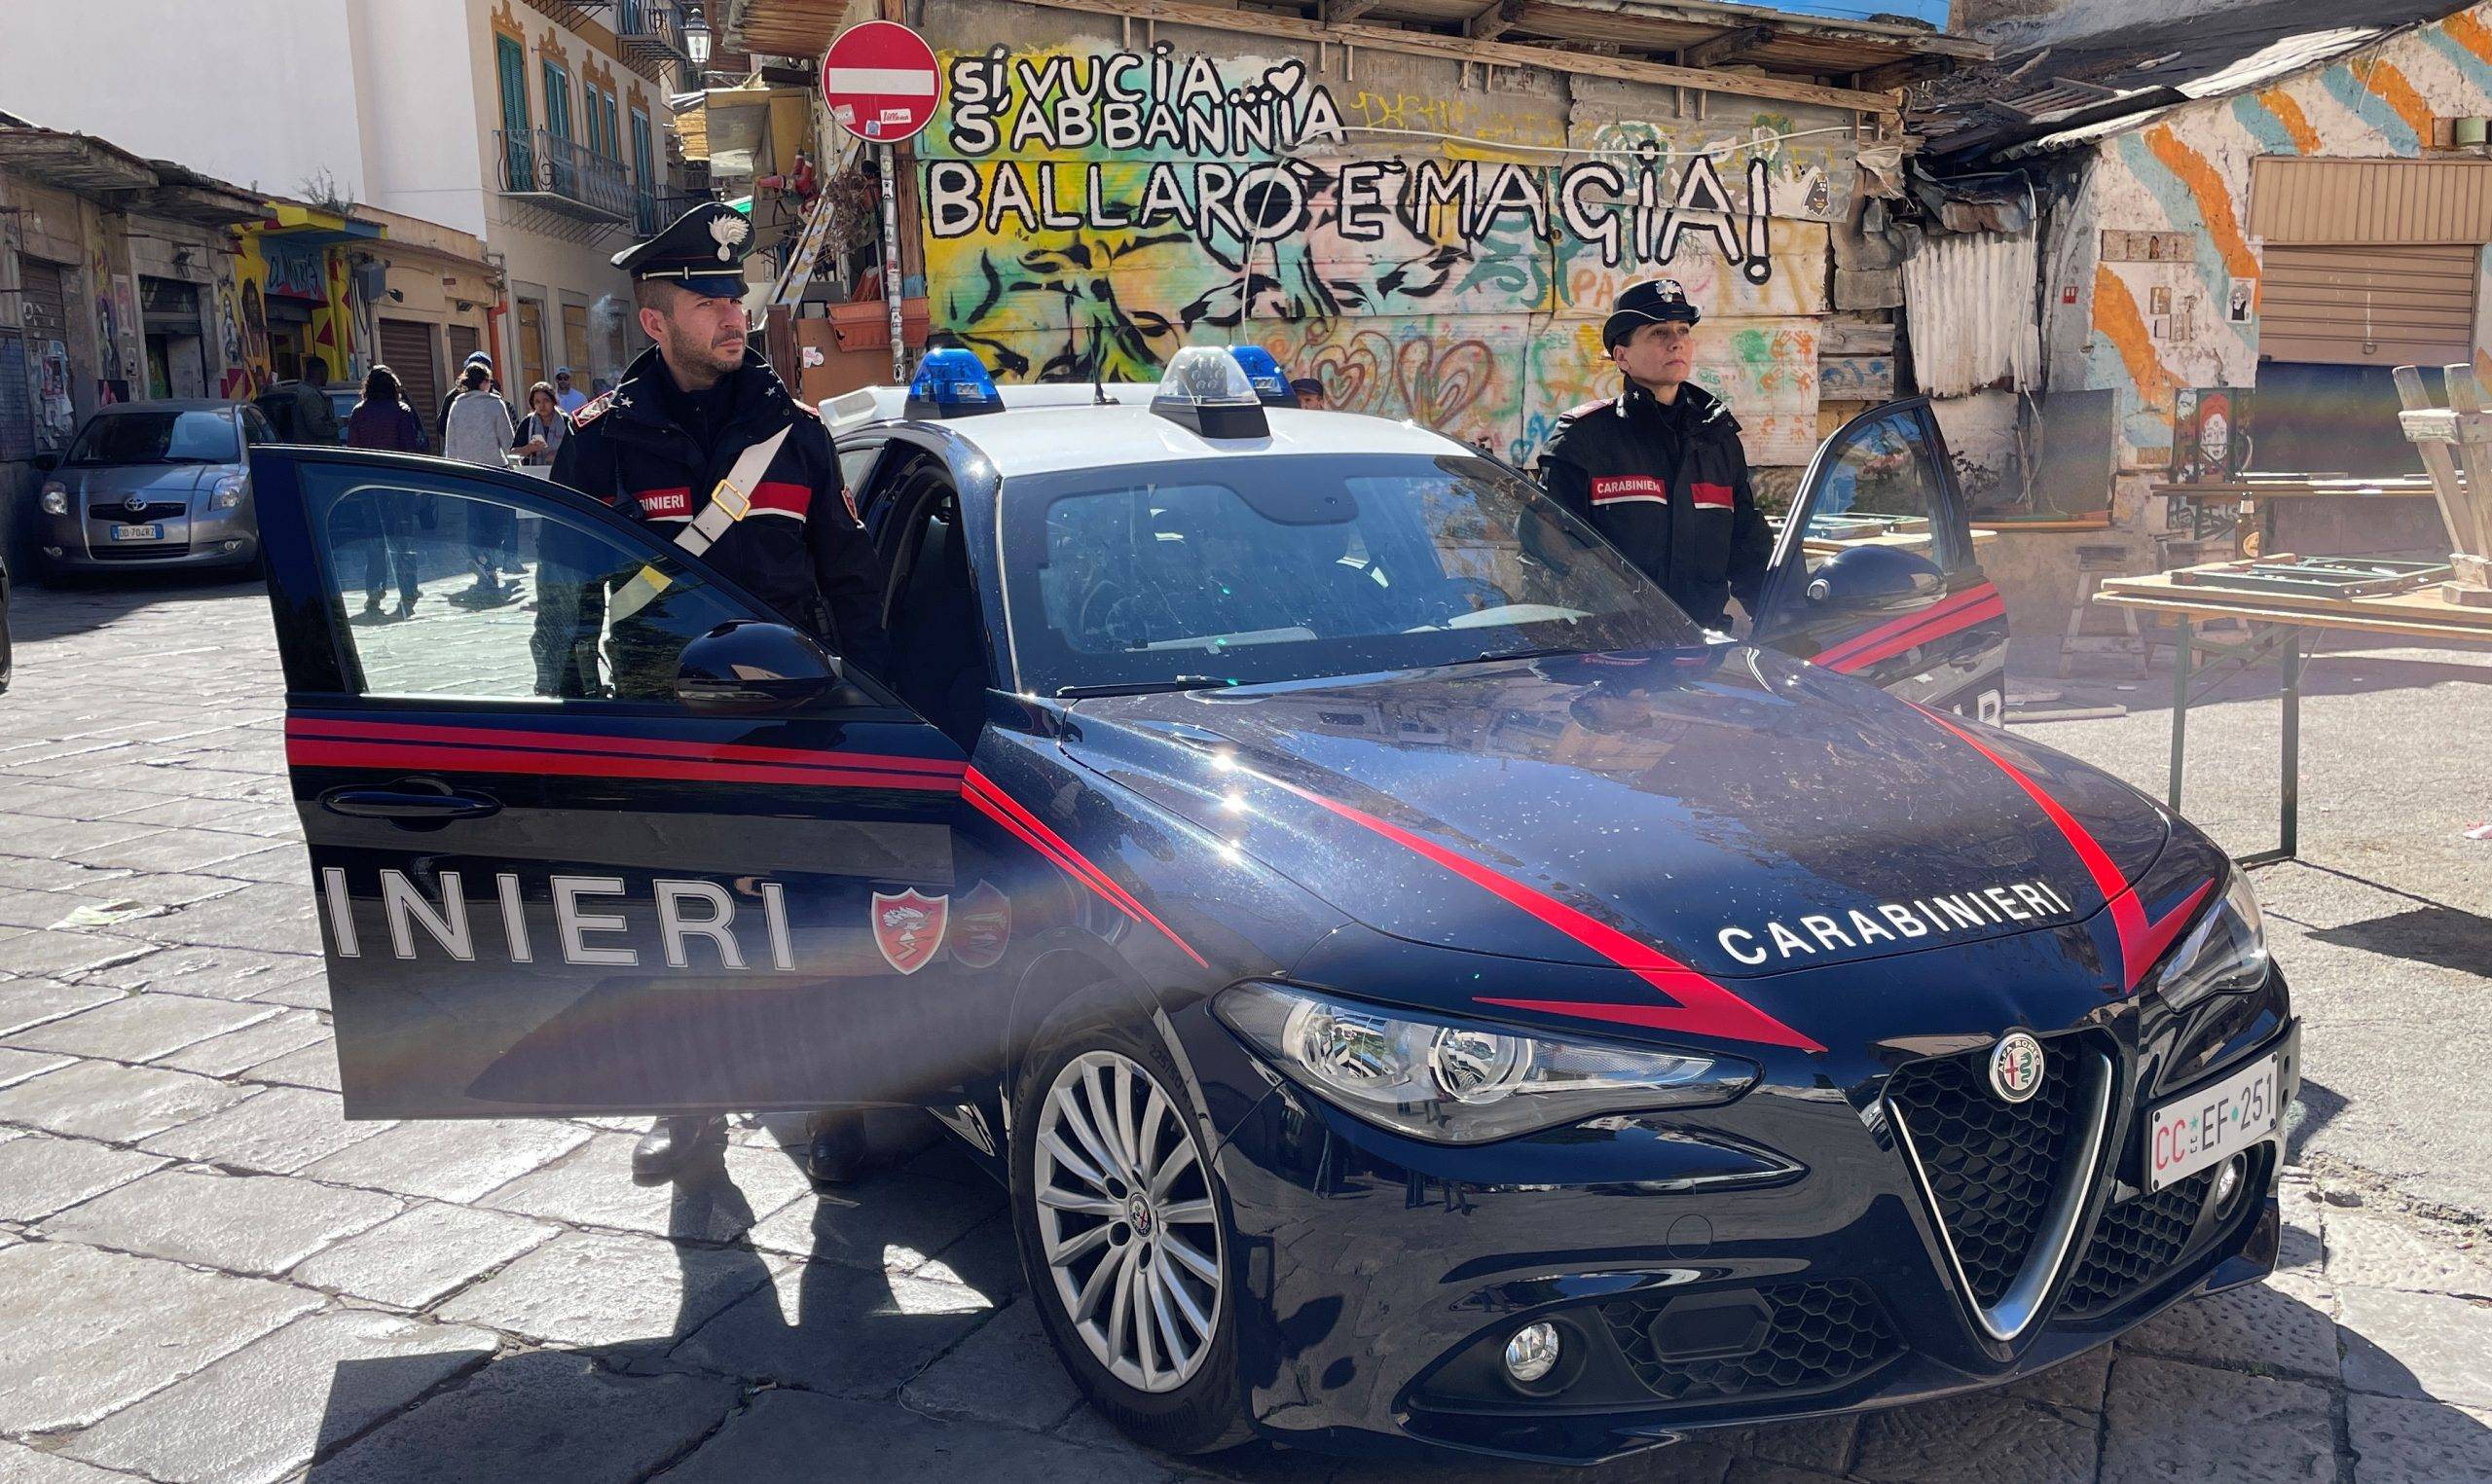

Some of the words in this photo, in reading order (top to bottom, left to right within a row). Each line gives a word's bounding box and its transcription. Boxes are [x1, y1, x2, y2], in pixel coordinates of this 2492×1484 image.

[322, 866, 796, 971] INIERI
[1717, 881, 2071, 965] CARABINIERI
[1998, 1046, 2012, 1072] ALFA
[2155, 1118, 2186, 1171] CC
[2201, 1098, 2229, 1151] EF
[2240, 1072, 2272, 1132] 251
